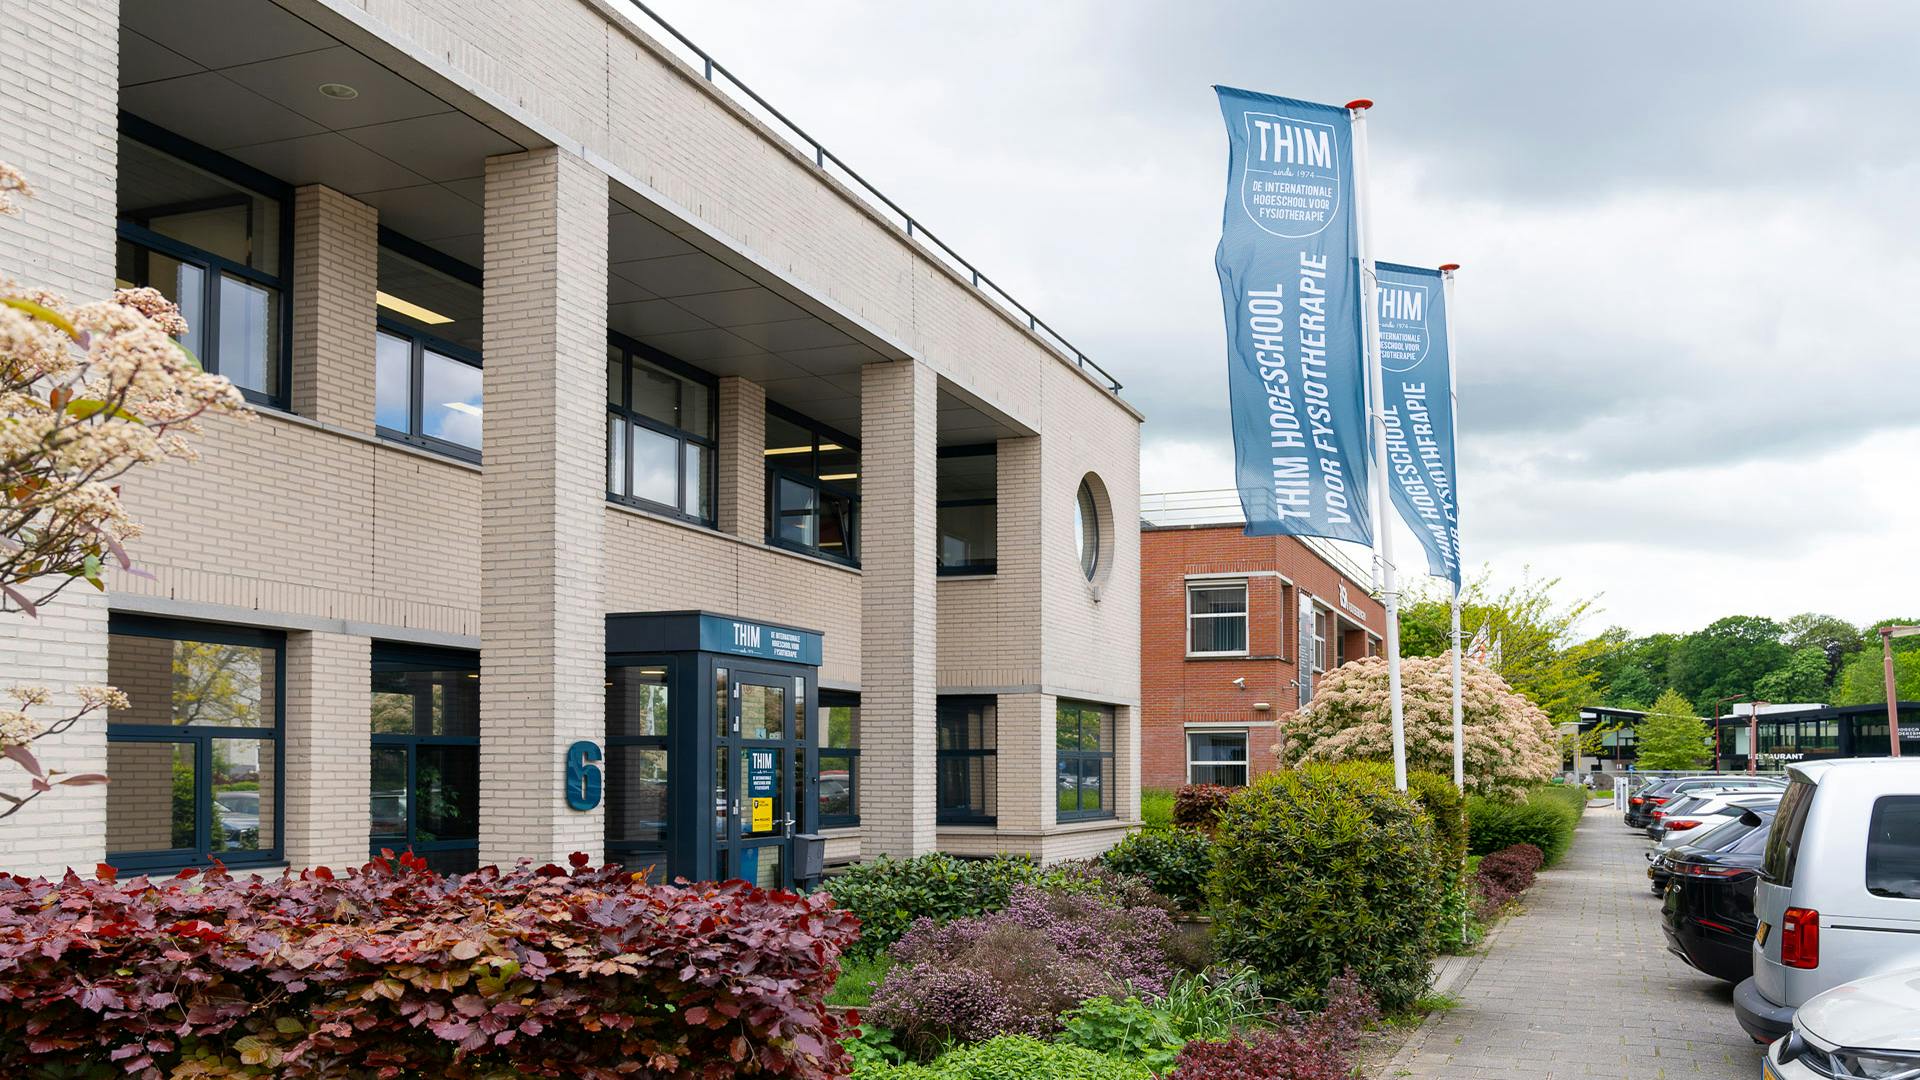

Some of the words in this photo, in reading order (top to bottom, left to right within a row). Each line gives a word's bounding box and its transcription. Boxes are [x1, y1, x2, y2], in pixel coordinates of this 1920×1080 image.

[1254, 121, 1332, 169] THIM
[1252, 181, 1263, 192] DE
[1265, 182, 1333, 198] INTERNATIONALE
[1297, 170, 1315, 178] 1974
[1253, 194, 1308, 208] HOGESCHOOL
[1309, 198, 1330, 210] VOOR
[1259, 207, 1325, 222] FYSIOTHERAPIE
[1247, 283, 1306, 448] HOGESCHOOL
[1299, 251, 1338, 453] FYSIOTHERAPIE
[1384, 405, 1441, 520] HOGESCHOOL
[1272, 457, 1311, 520] THIM
[1320, 457, 1351, 524] VOOR
[1427, 524, 1457, 569] THIM
[733, 623, 760, 648] THIM
[566, 740, 602, 811] 6
[752, 753, 772, 769] THIM
